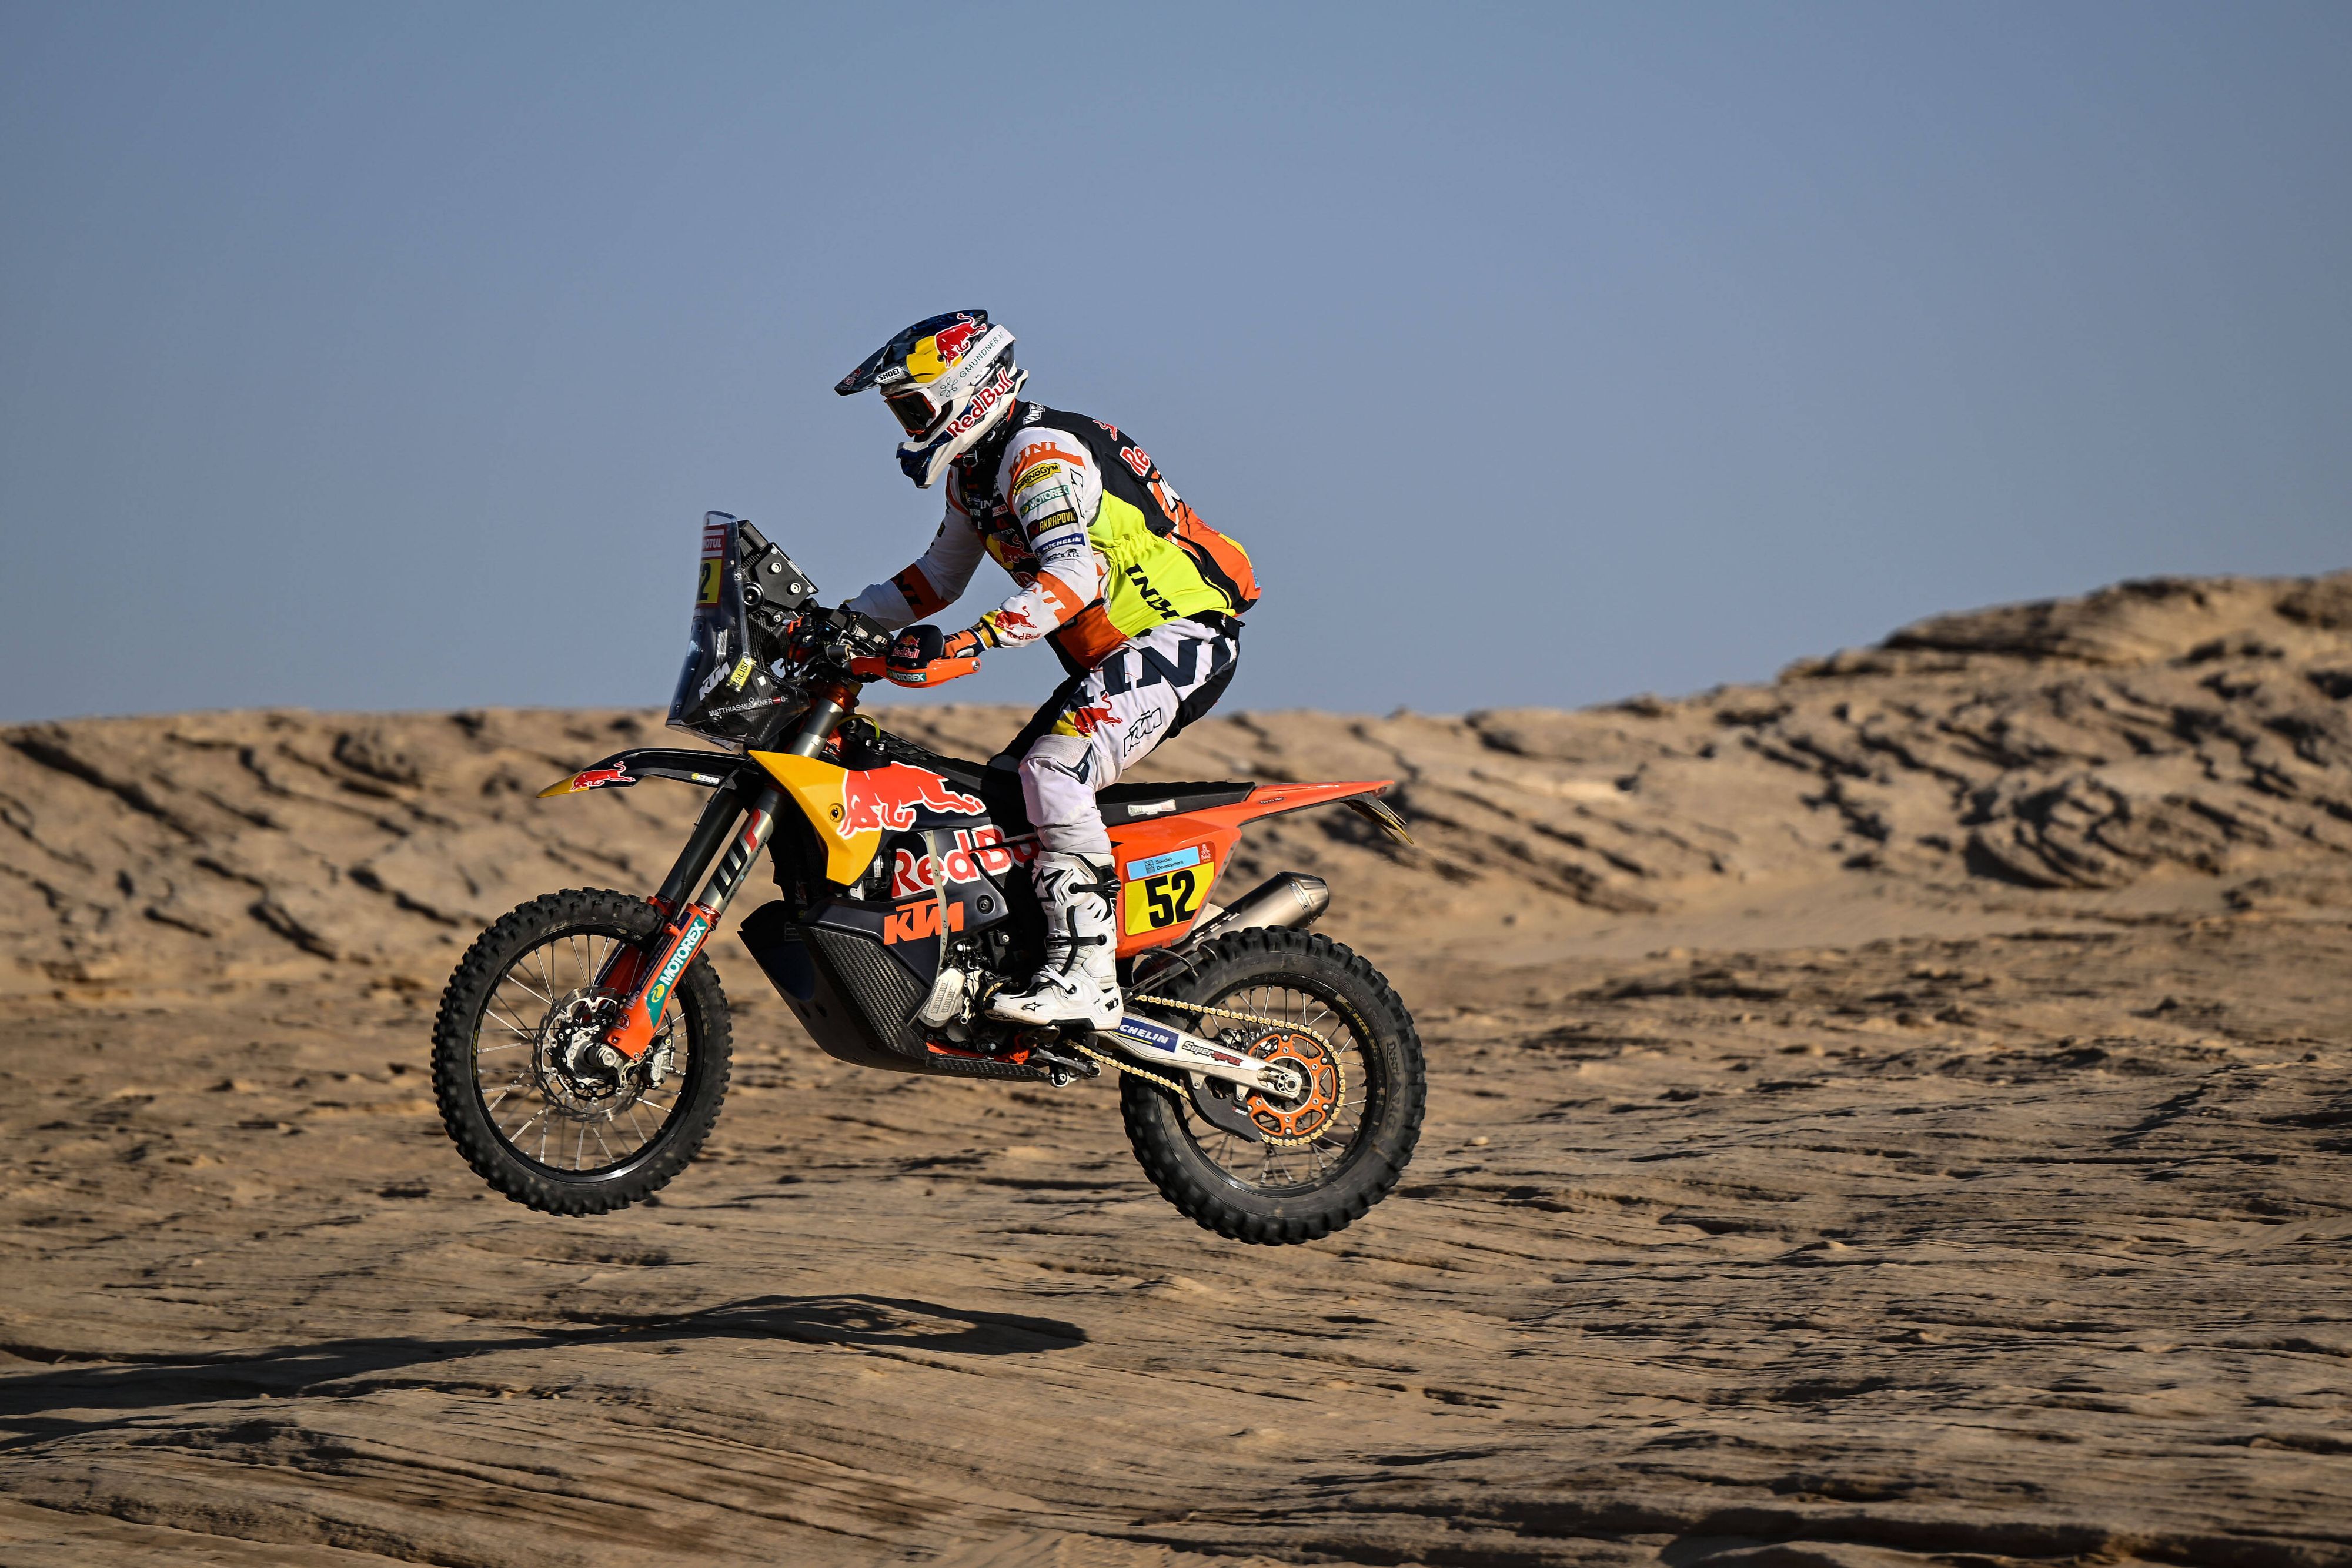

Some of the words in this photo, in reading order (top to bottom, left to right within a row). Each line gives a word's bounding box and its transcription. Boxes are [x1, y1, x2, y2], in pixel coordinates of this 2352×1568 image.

[878, 368, 900, 381] SHOEI
[1120, 446, 1152, 476] Re
[1030, 486, 1069, 509] MOTOREX
[1042, 537, 1082, 551] MICHELIN
[699, 562, 711, 601] 2
[1007, 631, 1024, 640] Red
[906, 647, 920, 659] Bull
[699, 661, 731, 701] KTM
[893, 673, 925, 681] MOTOREX
[708, 705, 743, 717] MATTHIAS
[1124, 707, 1162, 758] KTM
[691, 773, 720, 784] SCRUB
[892, 830, 975, 897] Red
[1157, 860, 1184, 871] Development
[1144, 870, 1196, 928] 52
[884, 898, 964, 945] KTM
[660, 921, 706, 986] MOTOREX
[1120, 1024, 1170, 1045] CHELIN
